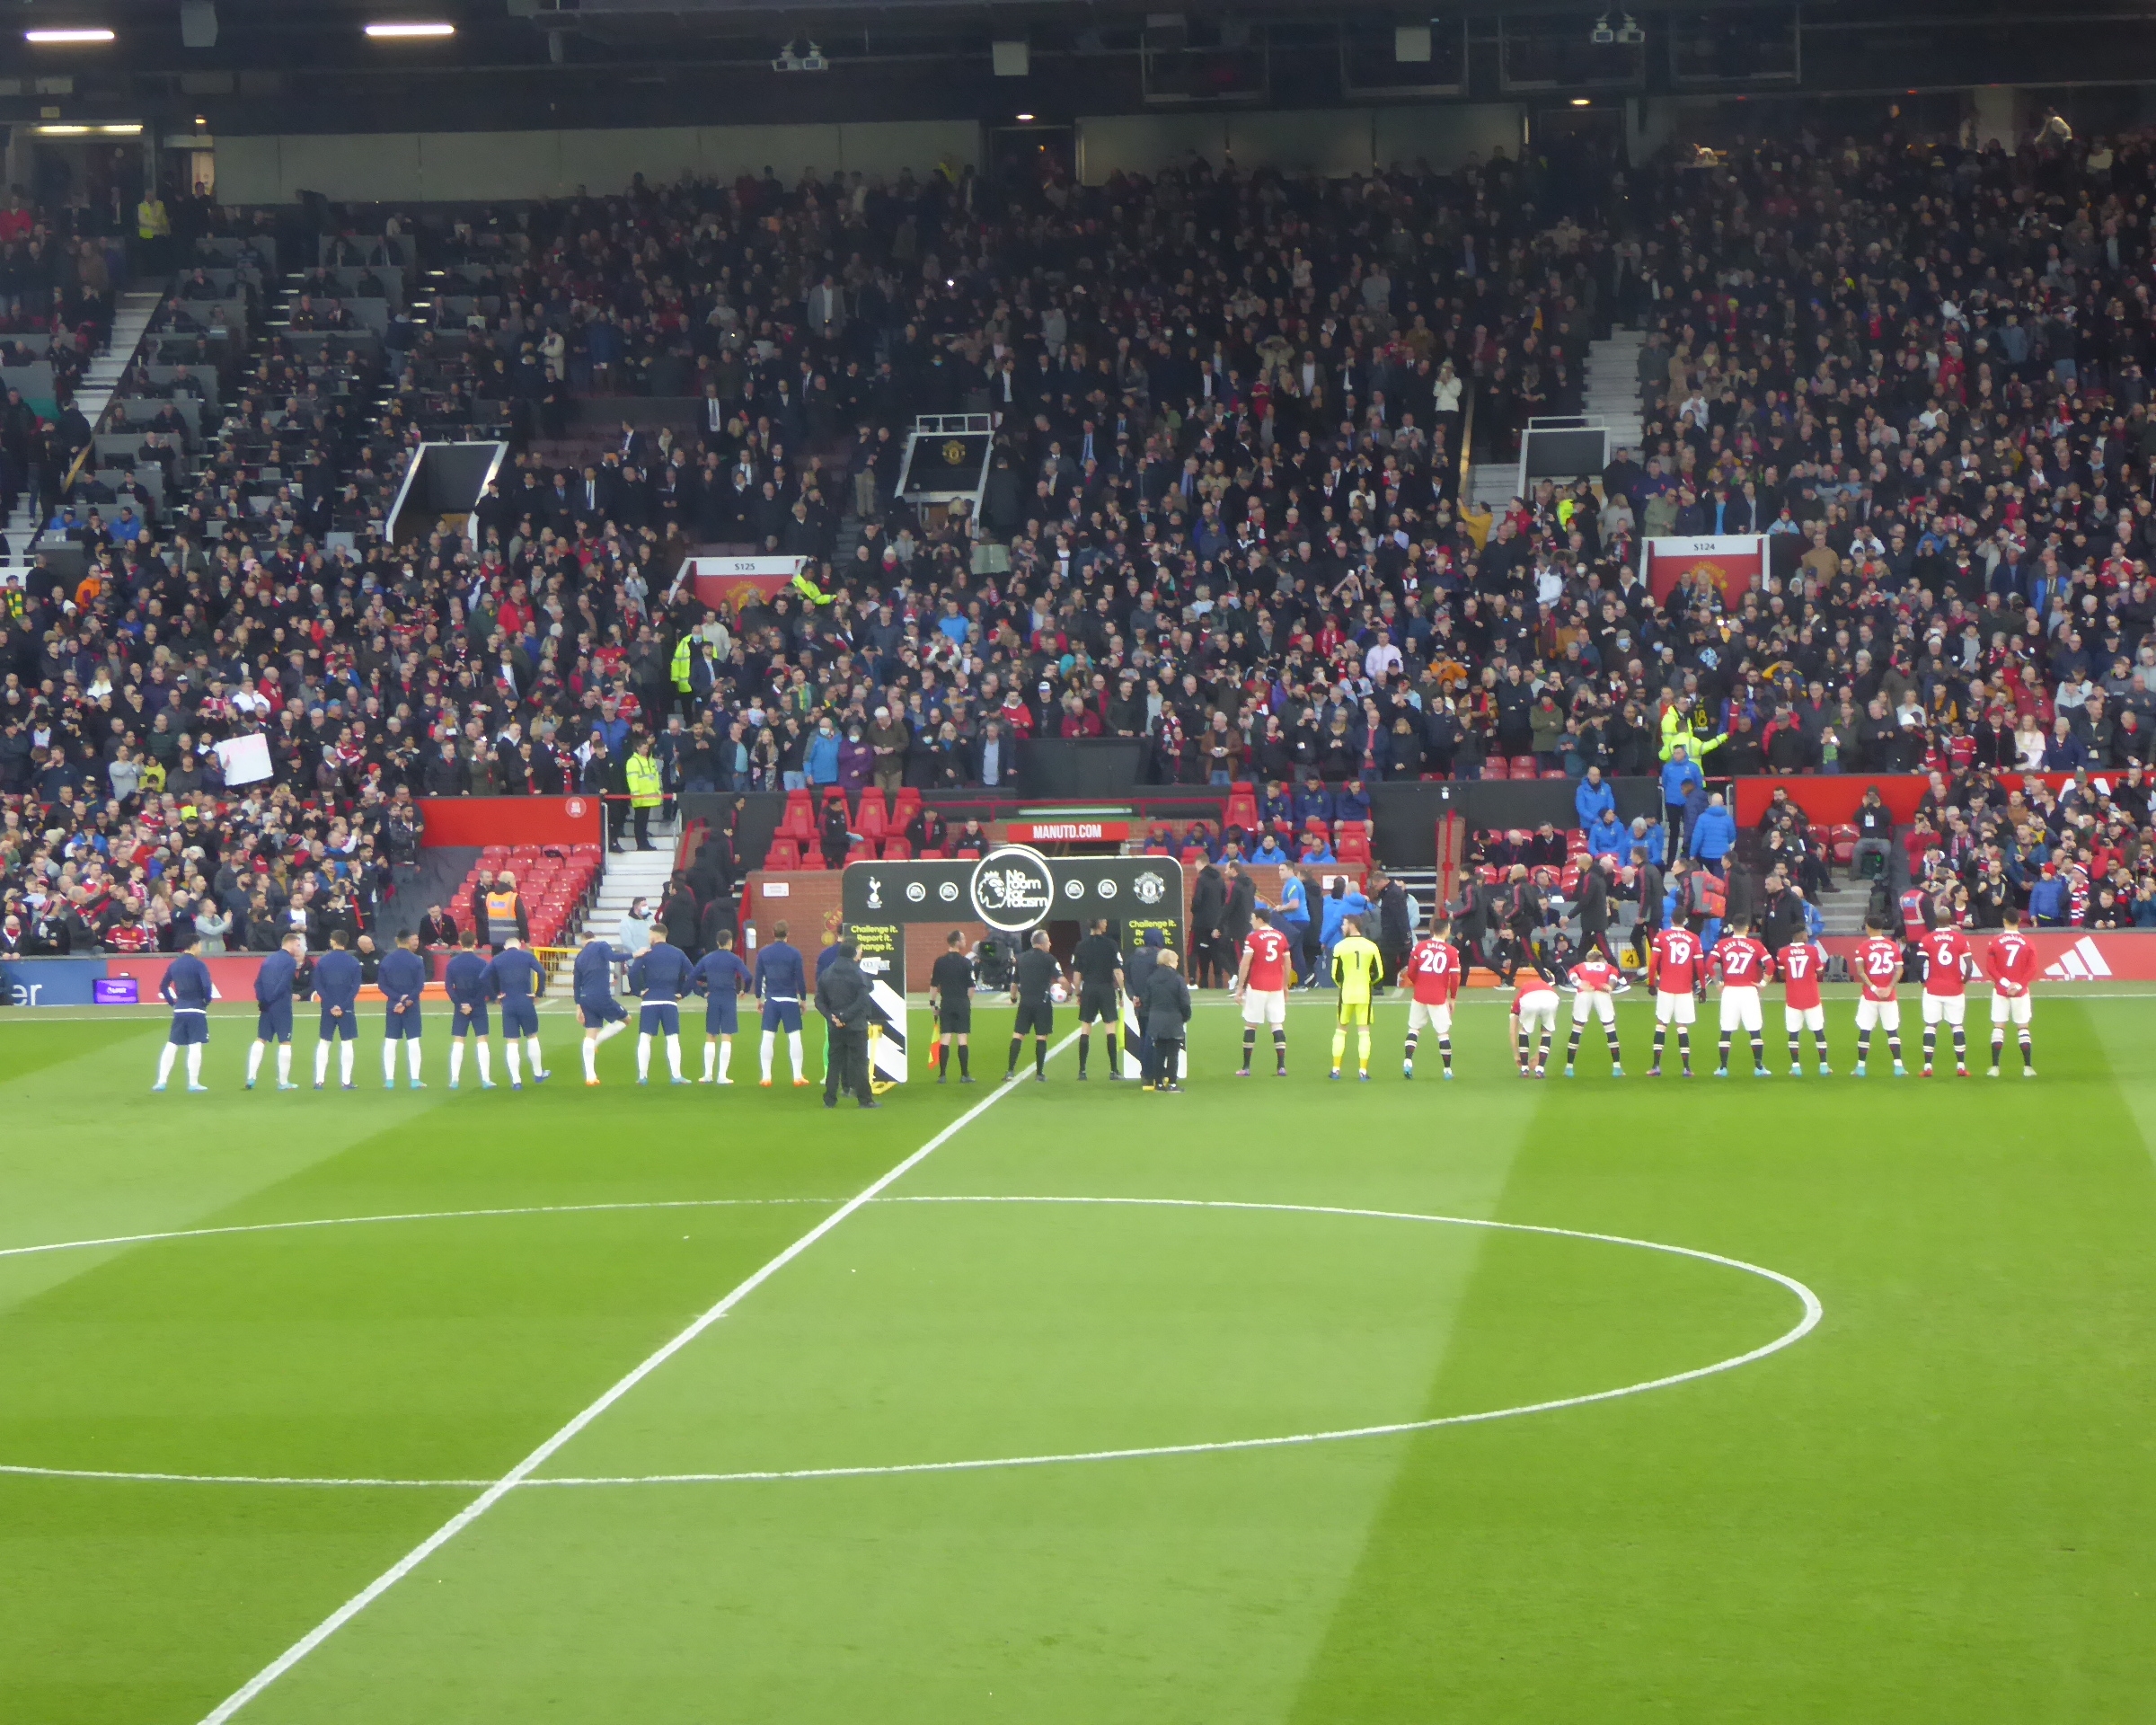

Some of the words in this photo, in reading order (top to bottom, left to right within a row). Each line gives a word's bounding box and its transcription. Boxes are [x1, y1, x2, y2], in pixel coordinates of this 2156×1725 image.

[1693, 543, 1715, 551] S124
[734, 562, 755, 571] S125
[1033, 824, 1102, 839] MANUTD.COM
[1006, 870, 1026, 881] No
[1006, 879, 1041, 890] room
[1006, 889, 1026, 899] for
[1006, 897, 1048, 907] racism
[850, 924, 889, 934] Challenge
[889, 924, 898, 933] it.
[1128, 920, 1167, 929] Challenge
[1168, 919, 1177, 927] it.
[856, 933, 883, 942] Report
[884, 933, 893, 942] it.
[859, 943, 885, 952] hange
[886, 942, 895, 951] it.
[1265, 940, 1278, 962] 5
[1669, 941, 1691, 965] 19
[1938, 942, 1953, 966] 6
[1354, 951, 1360, 970] 1
[1419, 949, 1448, 974] 20
[1726, 951, 1754, 974] 27
[2005, 943, 2020, 967] 7
[1787, 954, 1809, 978] 17
[1869, 951, 1895, 975] 25
[12, 984, 43, 1006] er
